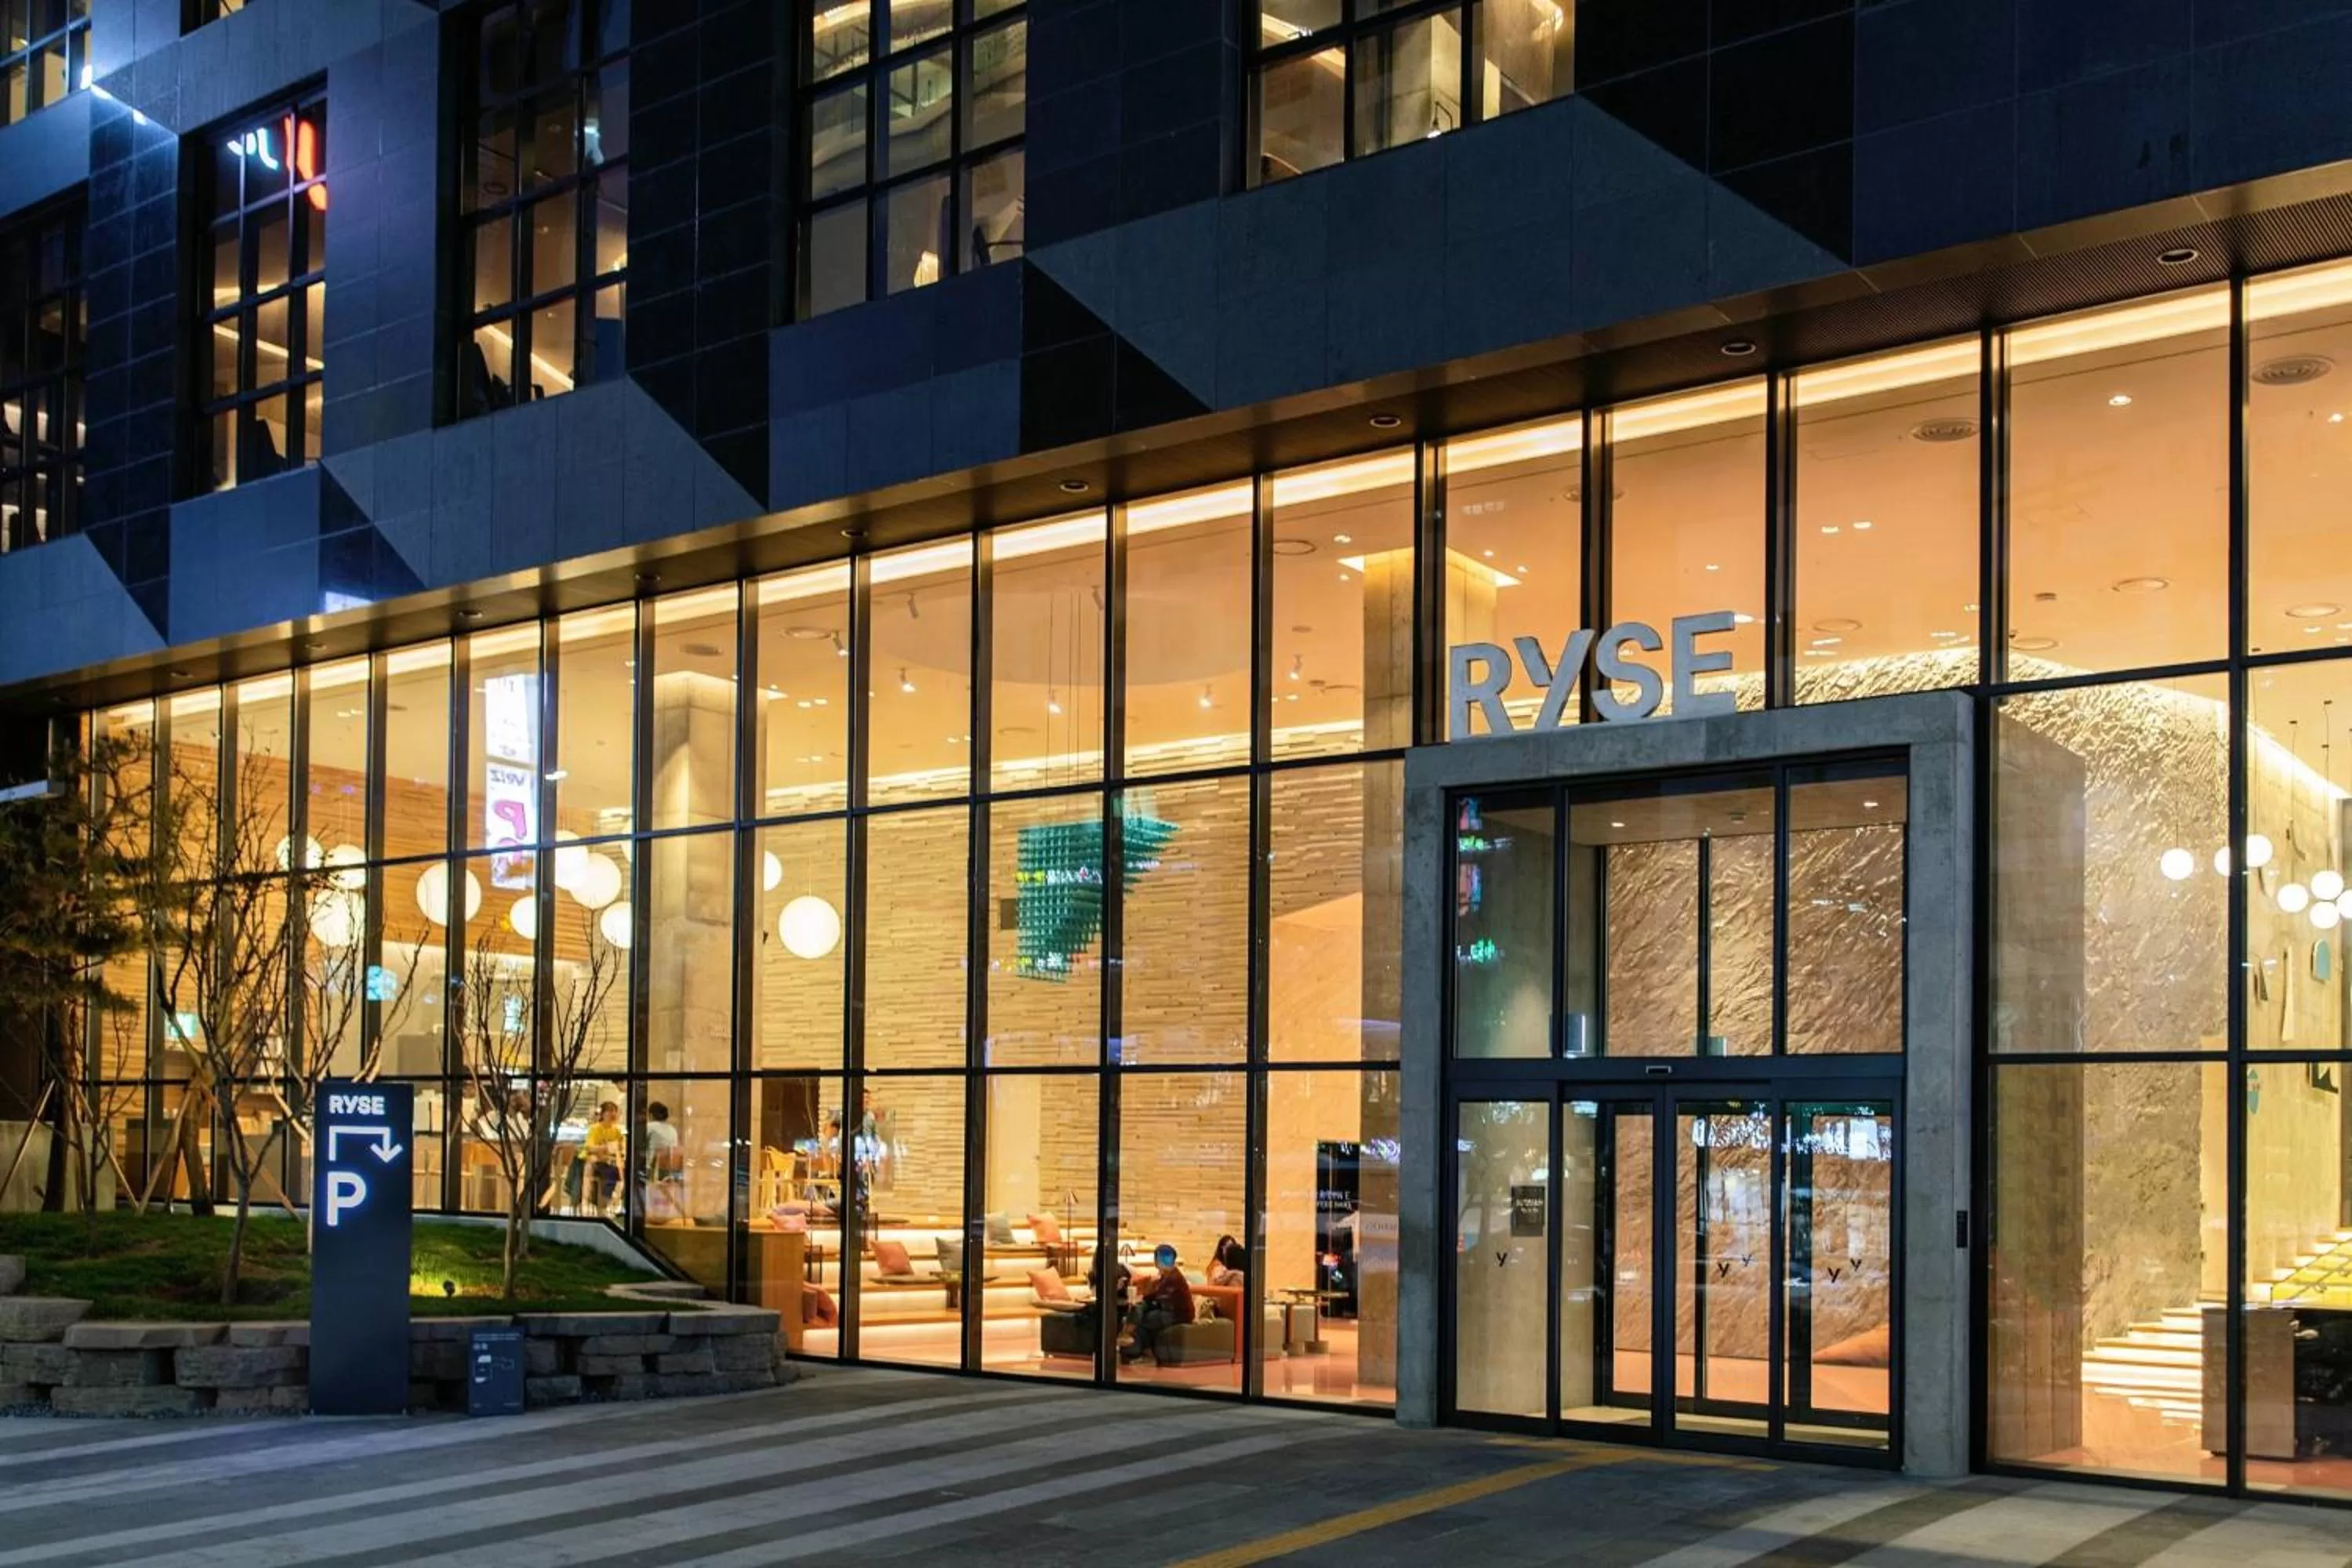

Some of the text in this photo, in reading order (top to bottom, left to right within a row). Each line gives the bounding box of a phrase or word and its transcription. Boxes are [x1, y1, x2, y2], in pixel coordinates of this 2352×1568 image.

[1450, 610, 1736, 740] RYSE
[329, 1094, 385, 1115] RYSE
[326, 1171, 367, 1226] P
